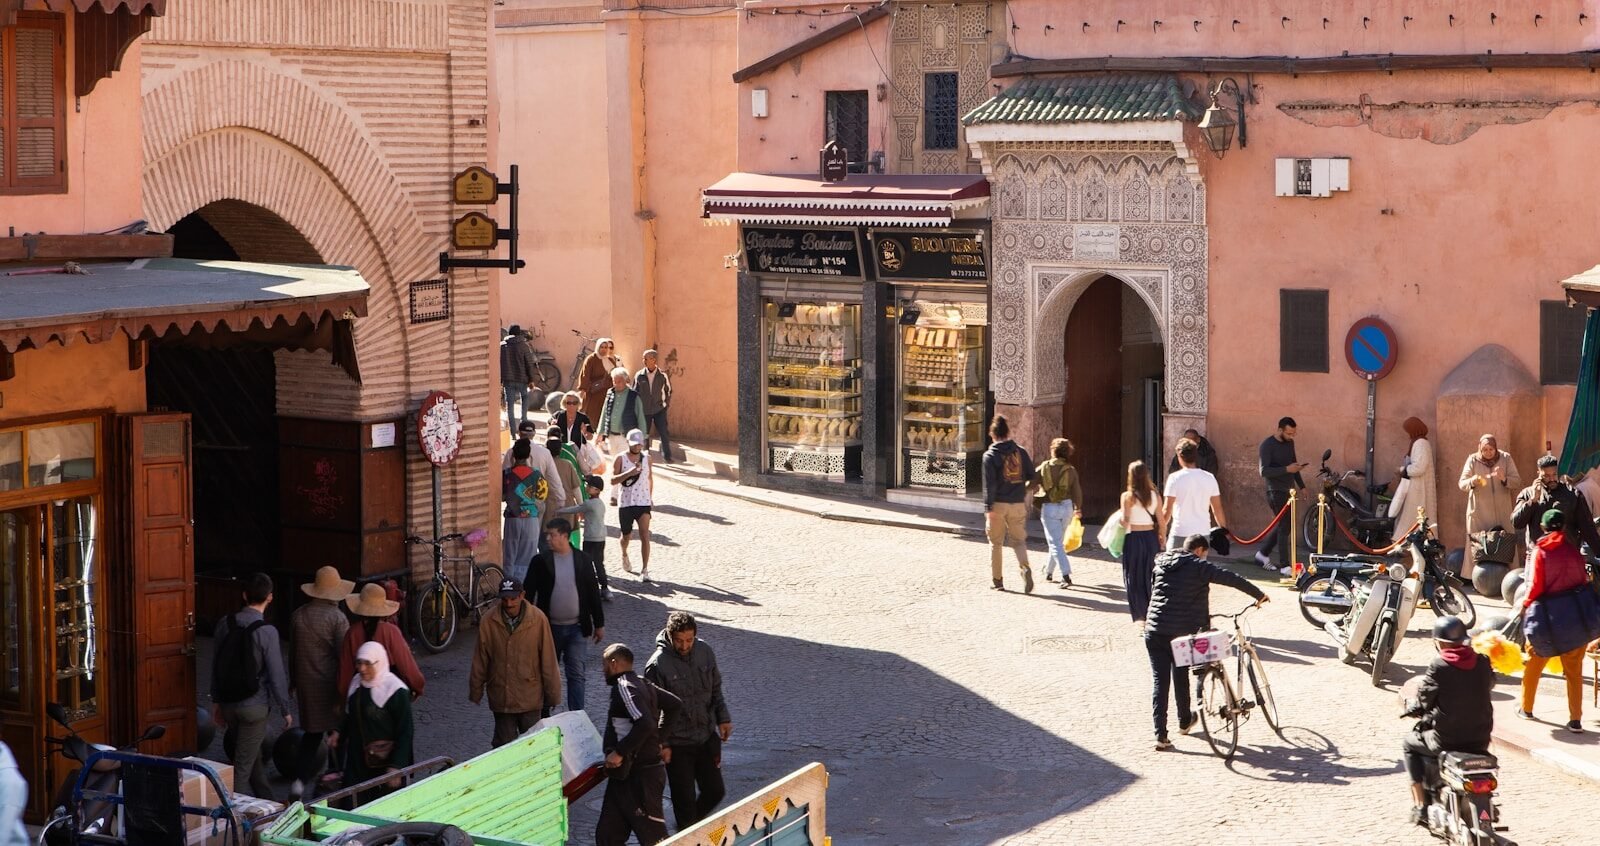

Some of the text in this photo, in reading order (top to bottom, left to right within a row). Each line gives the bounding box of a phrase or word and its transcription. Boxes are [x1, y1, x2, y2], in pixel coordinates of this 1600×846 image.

[912, 236, 982, 253] BIJOUTERIE
[884, 251, 895, 259] BM
[822, 256, 846, 266] N°154
